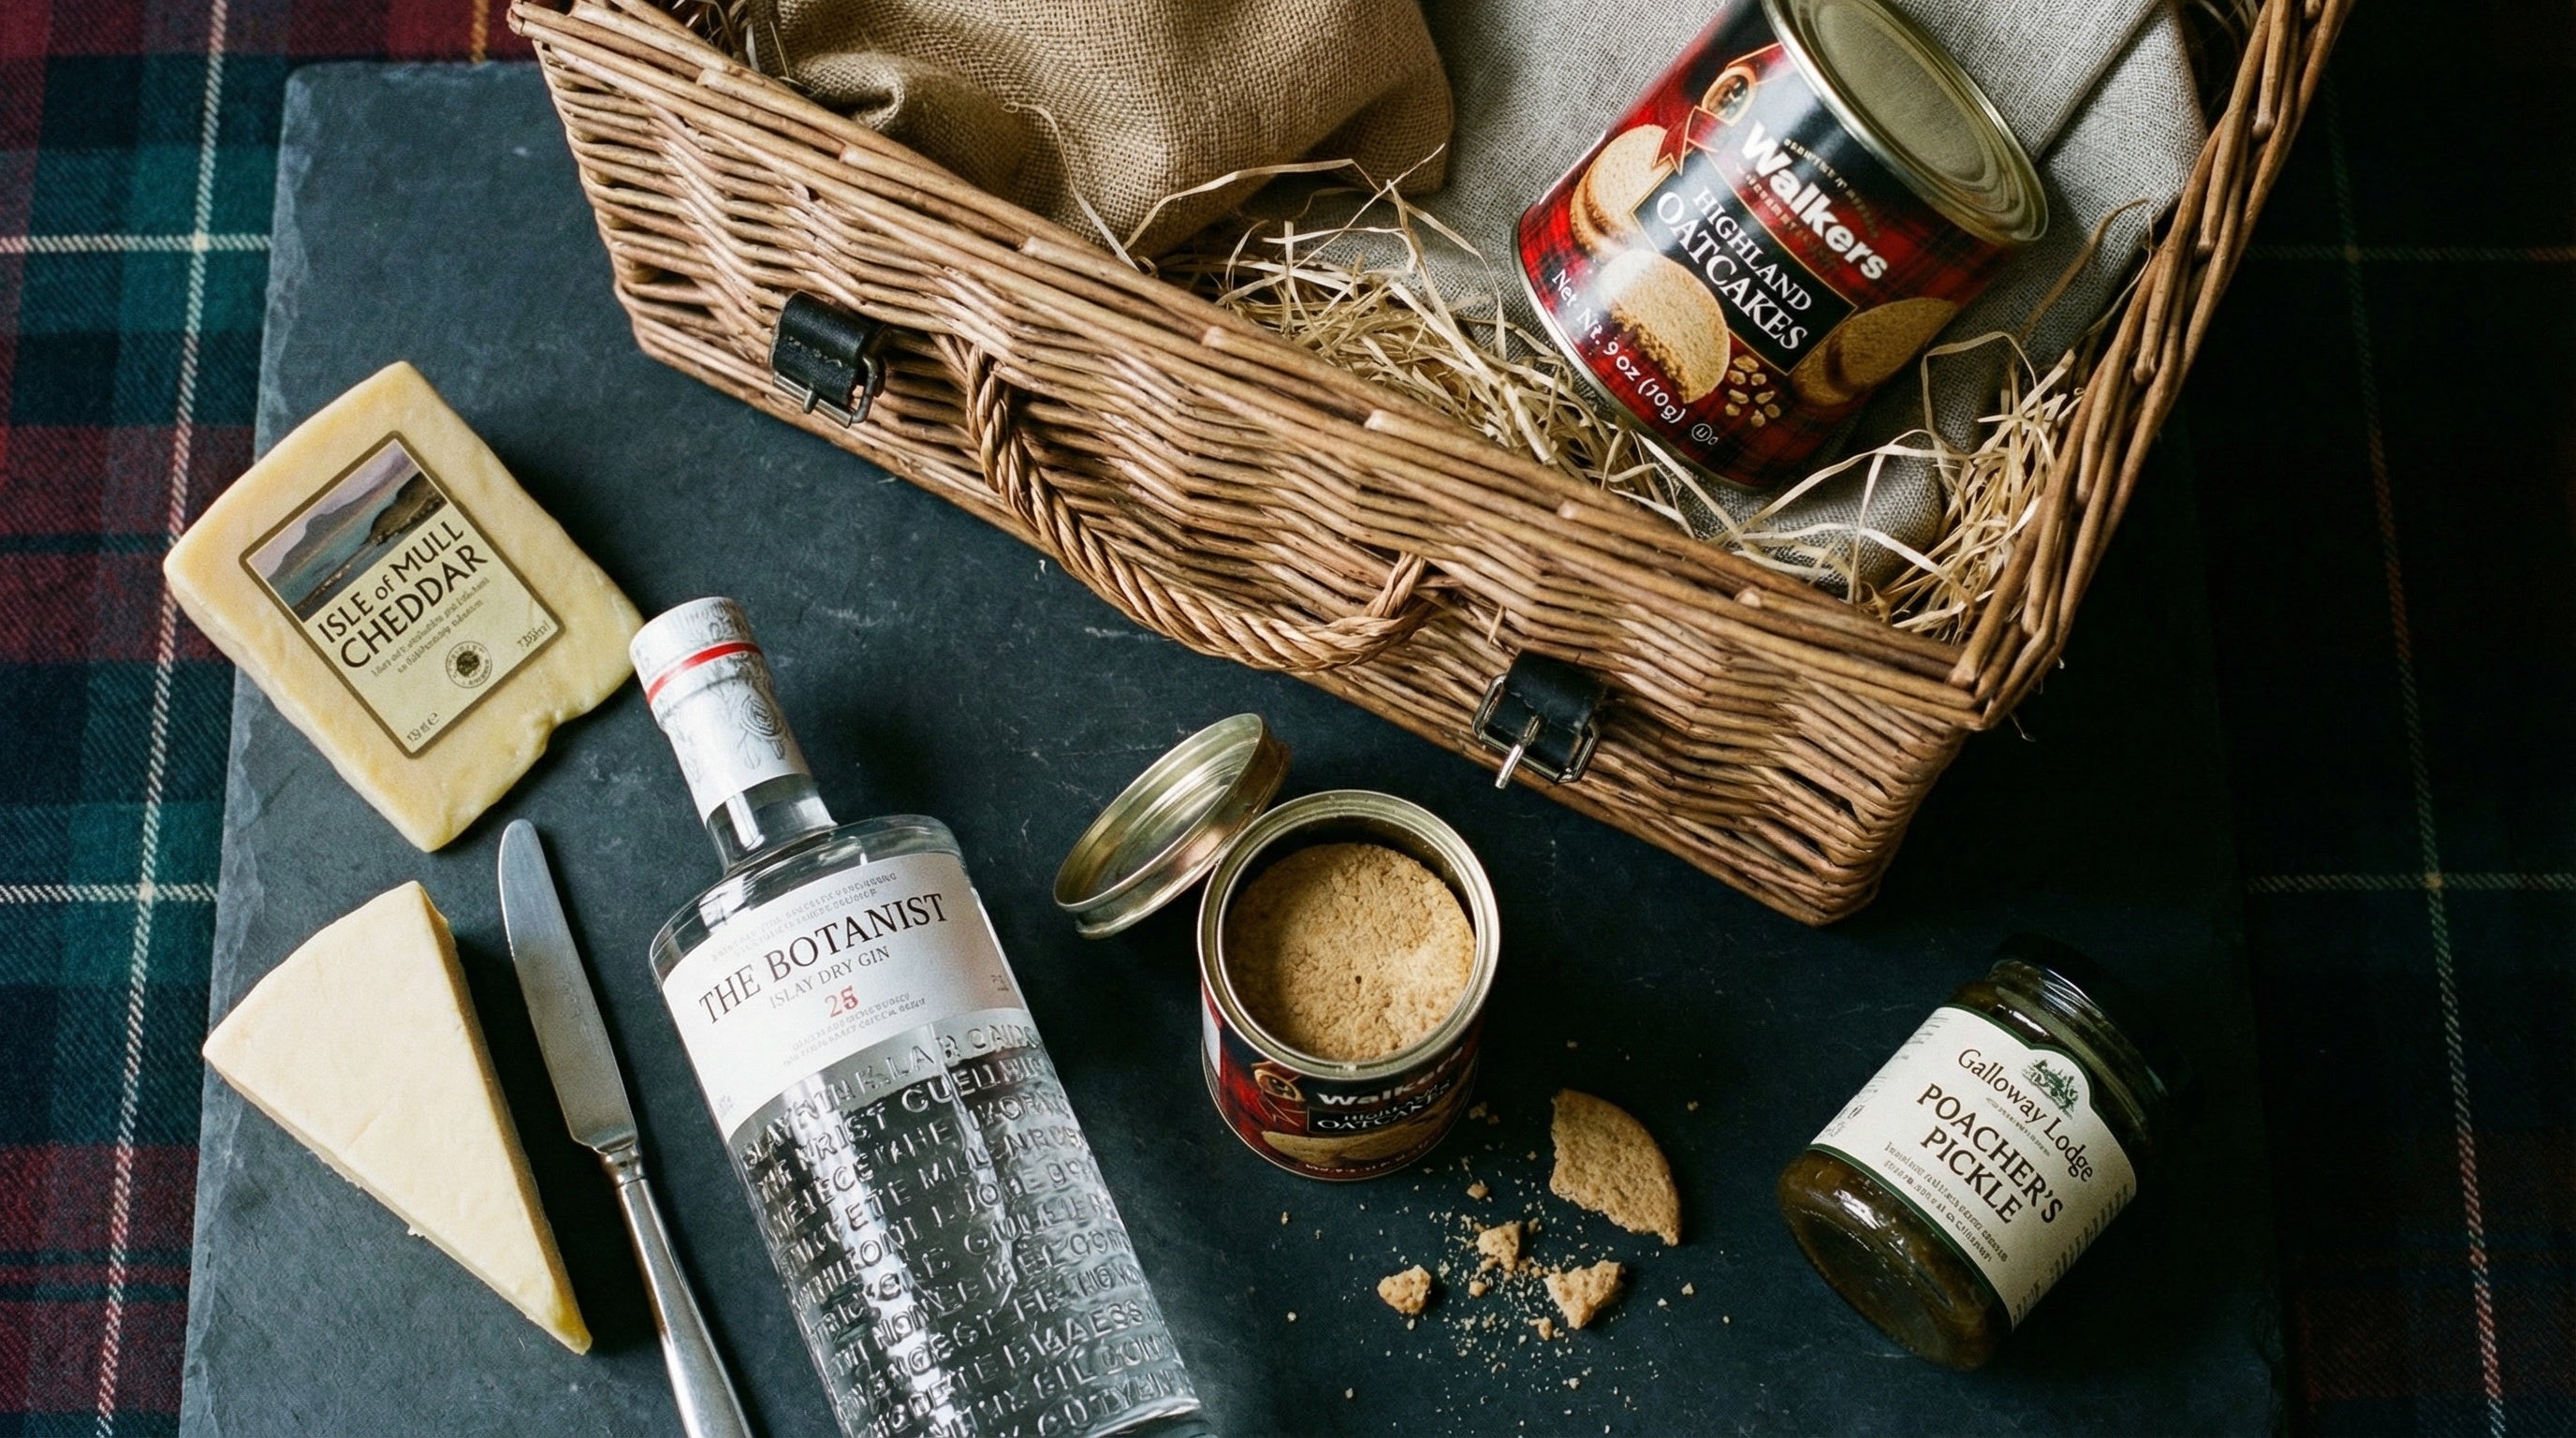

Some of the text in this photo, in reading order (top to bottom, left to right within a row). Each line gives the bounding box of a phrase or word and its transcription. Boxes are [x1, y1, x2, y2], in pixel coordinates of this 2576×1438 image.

[1693, 185, 1812, 312] HIGHLAND
[1741, 121, 1889, 281] Walkers
[1656, 192, 1808, 351] OATCAKES
[1603, 341, 1619, 356] 9
[1616, 356, 1641, 381] oz
[317, 590, 375, 644] ISLE
[374, 574, 396, 602] of
[390, 520, 464, 585] MULL
[340, 543, 488, 669] CHEDDAR
[698, 963, 762, 1024] THE
[763, 892, 947, 983] BOTANIST
[769, 945, 890, 1010] ISLAY DRY GIN
[1921, 1125, 2024, 1225] PICKLE
[1958, 1047, 2048, 1125] Galloway
[2044, 1118, 2094, 1183] Lodge
